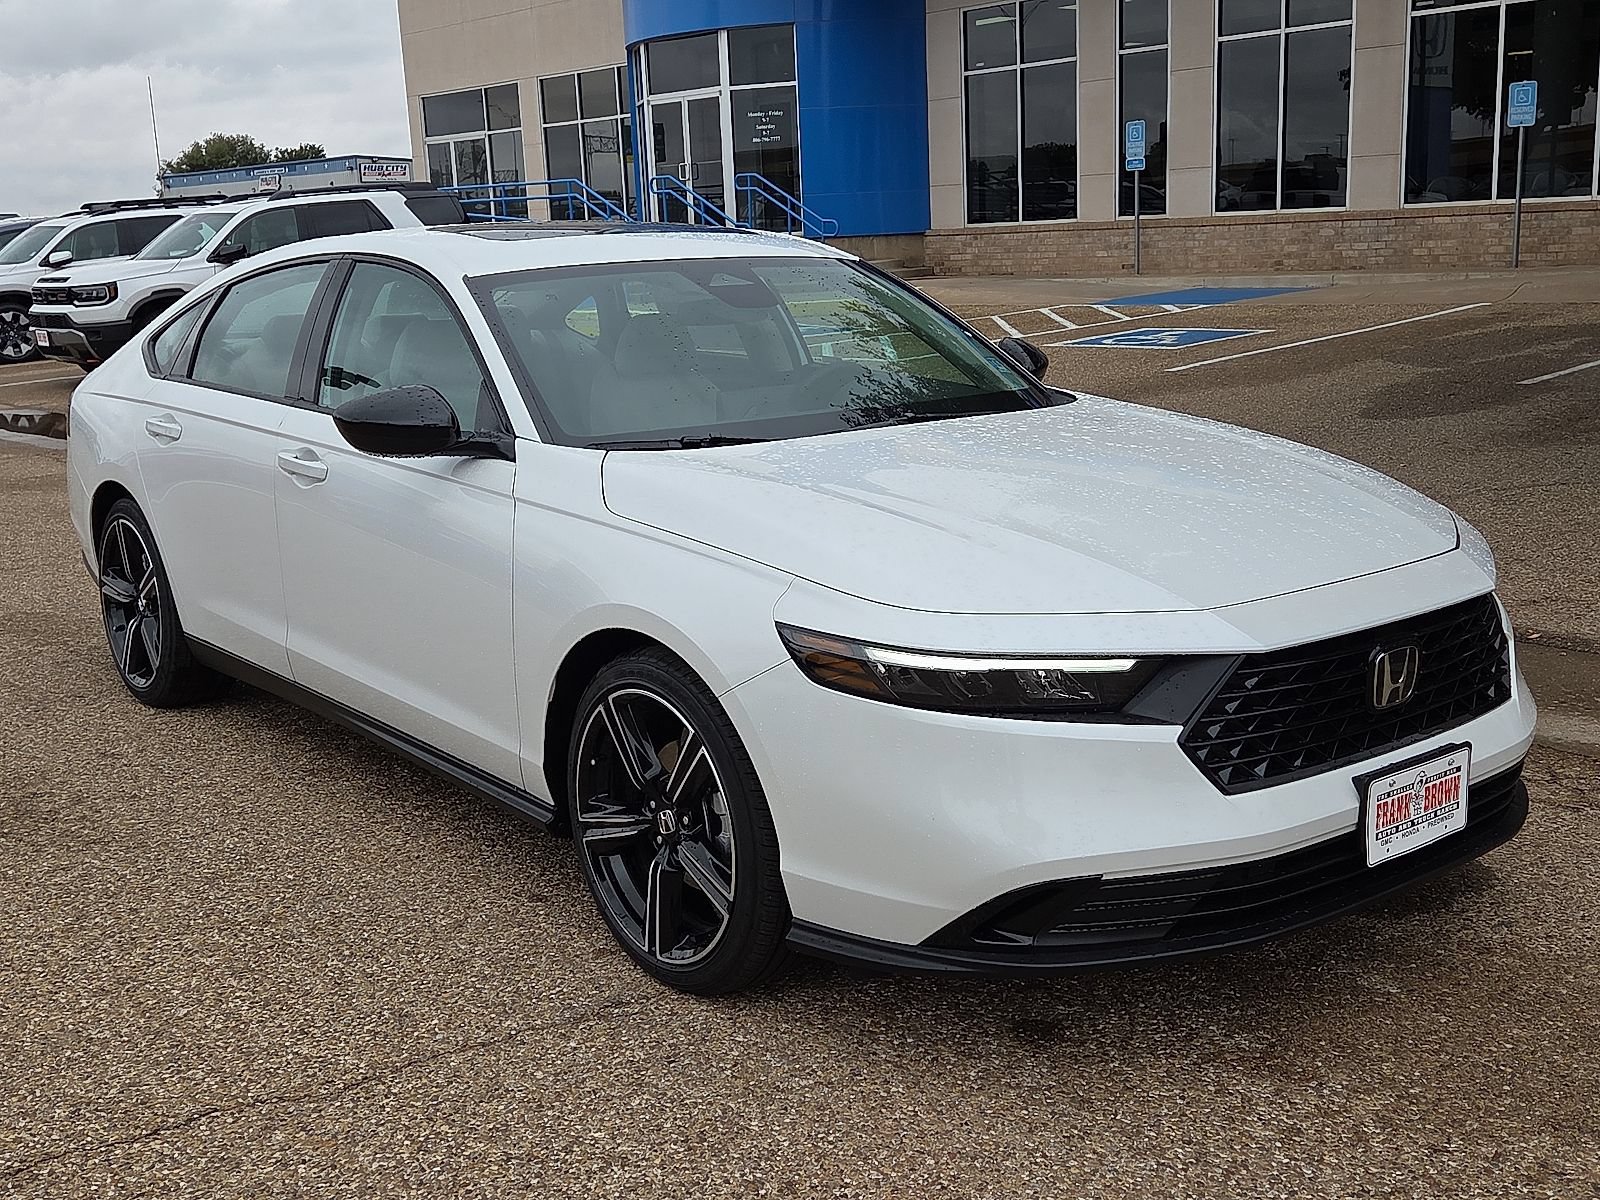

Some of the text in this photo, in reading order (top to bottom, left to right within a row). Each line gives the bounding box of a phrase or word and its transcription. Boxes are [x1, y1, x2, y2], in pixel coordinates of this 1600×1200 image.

[1375, 775, 1461, 830] FRANK BROWN
[1378, 804, 1458, 839] AUTO AND TRUCK RANCH
[1380, 812, 1455, 846] GMC HONDA PREOWNED
